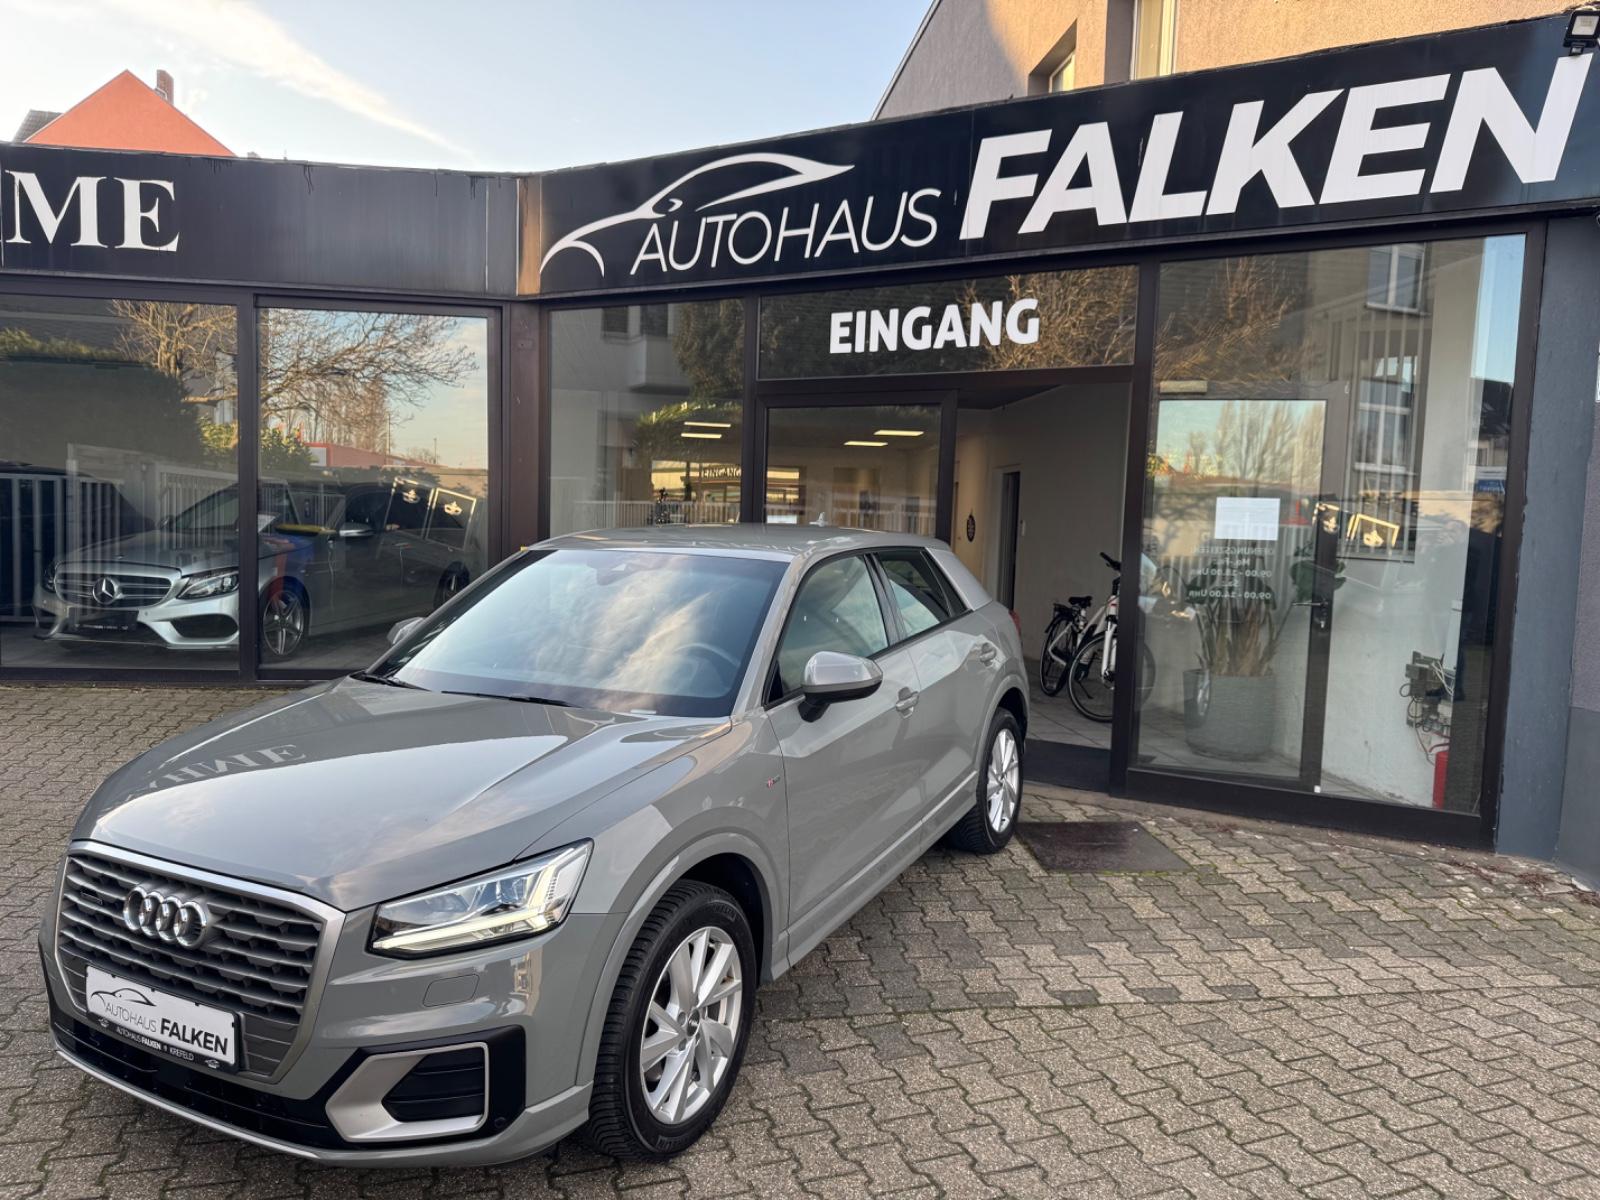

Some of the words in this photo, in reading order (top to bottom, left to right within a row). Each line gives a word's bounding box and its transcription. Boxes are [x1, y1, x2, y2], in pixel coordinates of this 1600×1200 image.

[630, 187, 942, 277] AUTOHAUS
[959, 53, 1594, 241] FALKEN
[829, 298, 1040, 354] EINGANG
[105, 1002, 157, 1033] AUTOHAUS
[160, 1017, 228, 1056] FALKEN
[141, 1036, 161, 1050] FALKEN
